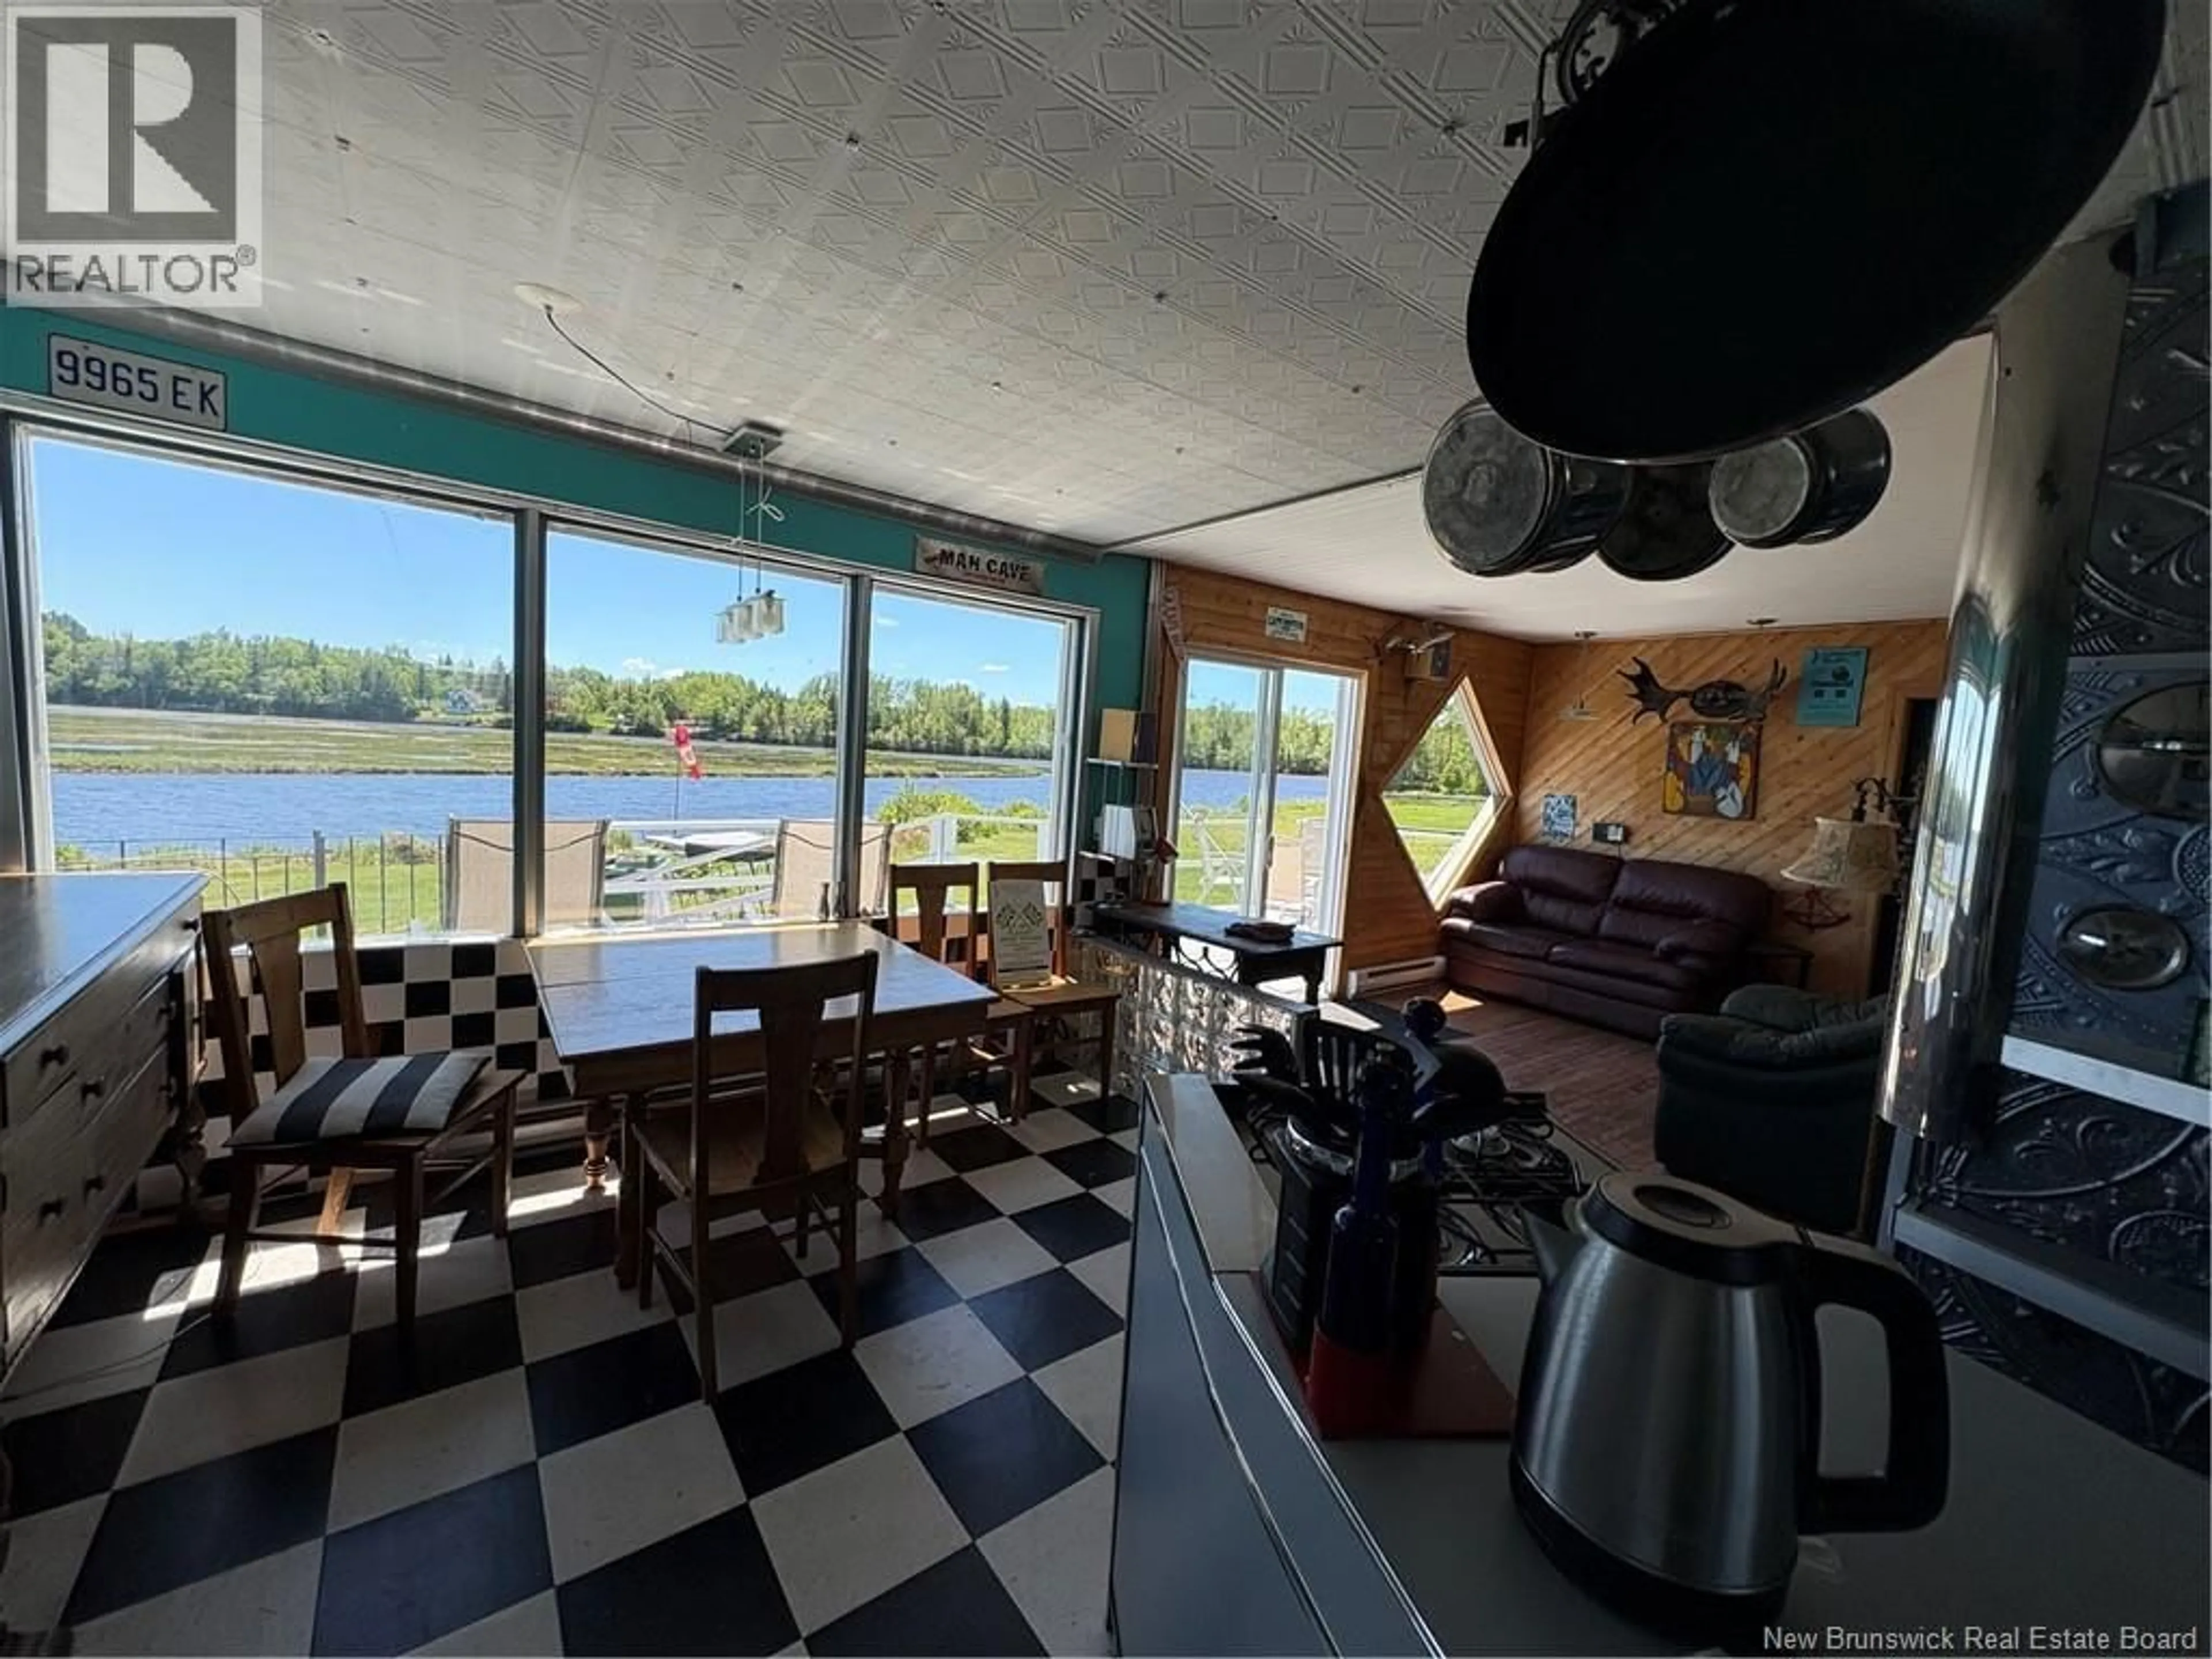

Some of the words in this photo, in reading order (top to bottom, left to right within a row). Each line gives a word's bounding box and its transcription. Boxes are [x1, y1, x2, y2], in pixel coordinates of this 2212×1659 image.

[57, 349, 159, 402] 9965
[172, 375, 219, 416] EK
[939, 548, 980, 571] MAN
[986, 559, 1031, 582] CAVE
